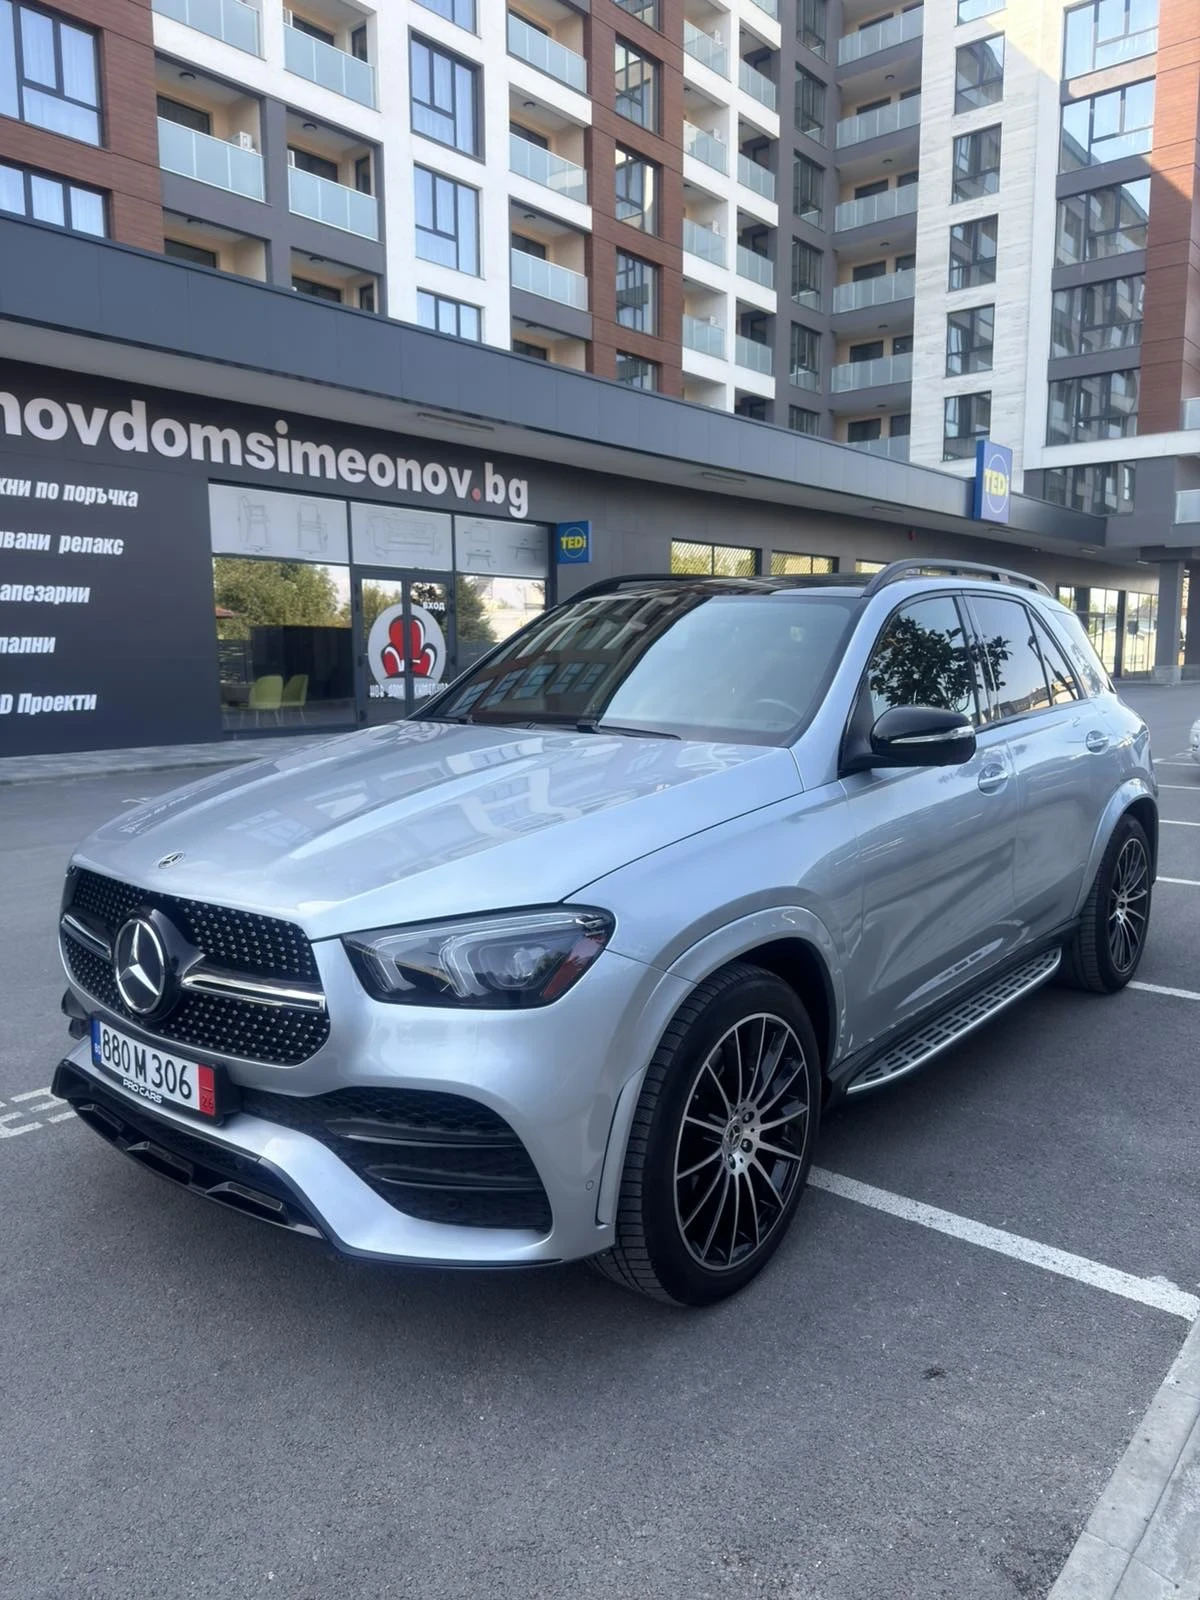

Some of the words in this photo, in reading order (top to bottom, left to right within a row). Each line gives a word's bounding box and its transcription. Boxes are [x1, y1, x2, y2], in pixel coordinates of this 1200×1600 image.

[35, 480, 60, 500] по
[63, 484, 139, 508] поръчка
[983, 467, 1009, 496] TEDi
[59, 535, 124, 556] релакс
[560, 535, 587, 550] TEDi
[0, 584, 91, 605] апезарии
[17, 693, 98, 716] Проекти
[102, 1028, 131, 1074] 880
[151, 1053, 192, 1100] 306
[123, 1077, 140, 1094] PRO
[140, 1087, 162, 1104] CARS
